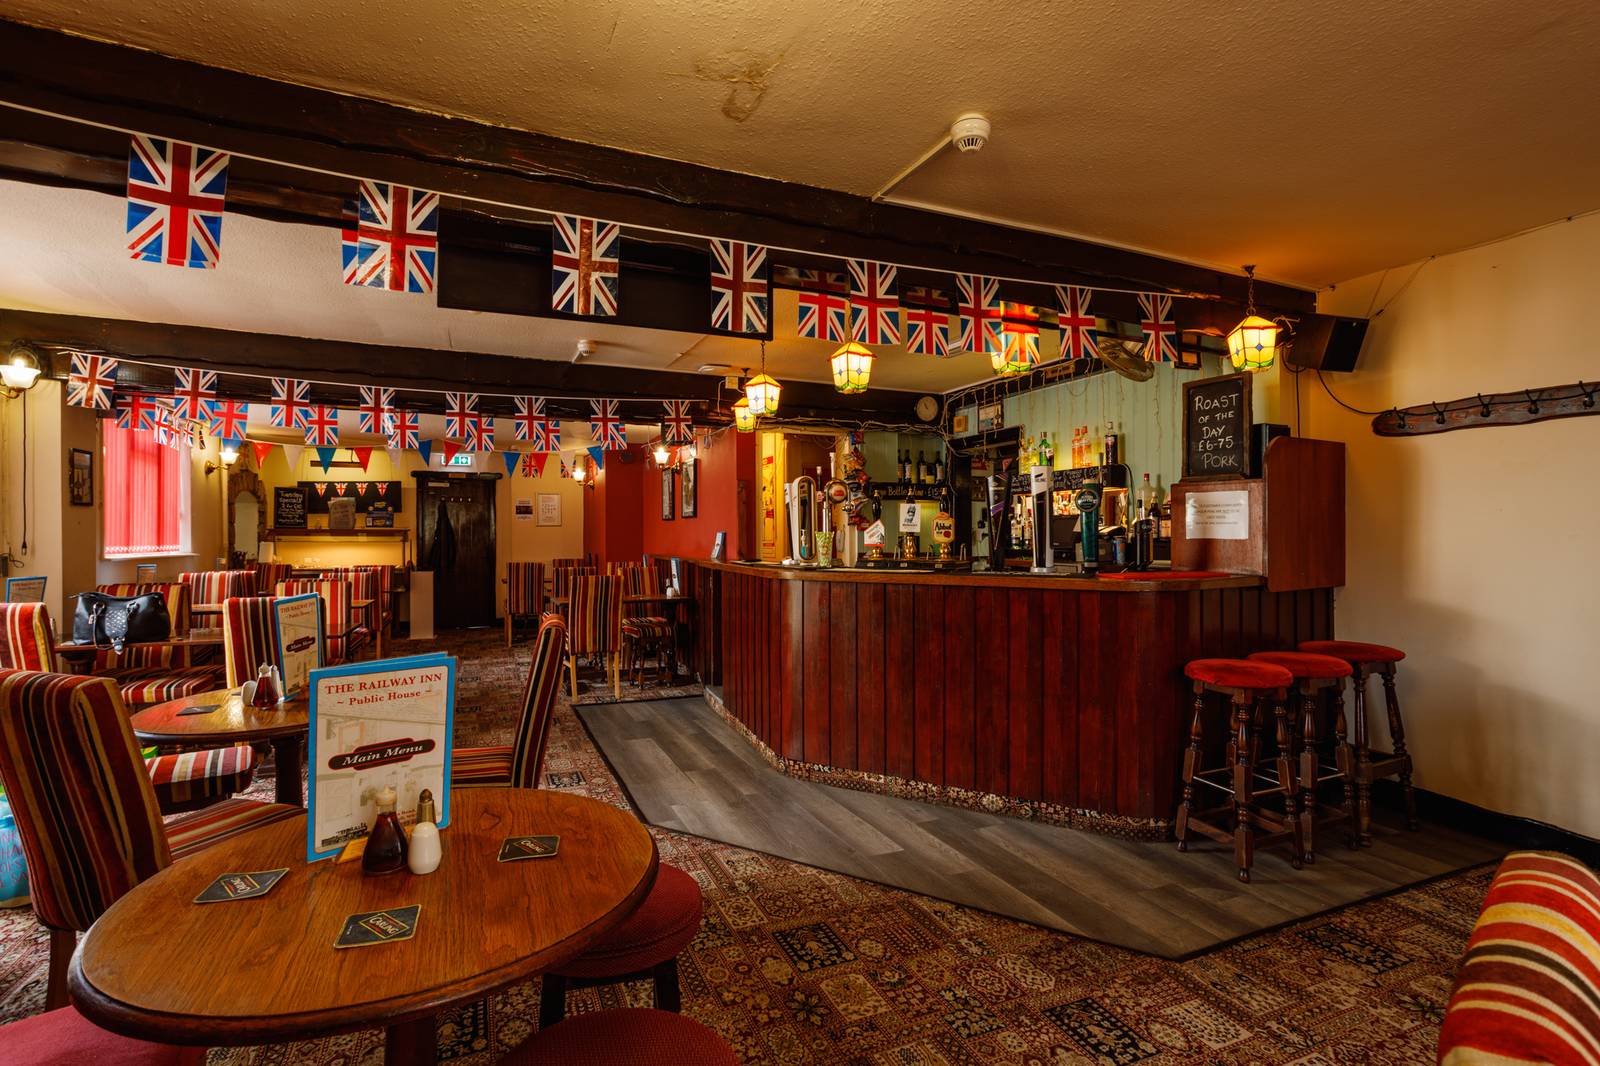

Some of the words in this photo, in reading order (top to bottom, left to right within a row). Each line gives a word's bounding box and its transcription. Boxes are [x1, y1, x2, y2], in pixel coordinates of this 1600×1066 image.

[1194, 393, 1240, 411] ROAST
[1198, 415, 1210, 424] OF
[1214, 410, 1235, 421] THE
[1202, 425, 1226, 440] DAY
[1201, 452, 1239, 469] PORK
[324, 683, 355, 695] THE
[359, 675, 417, 692] RAILWAY
[420, 672, 443, 684] INN
[349, 694, 385, 706] Public
[388, 690, 421, 701] House
[341, 751, 381, 766] Main
[383, 744, 424, 759] Menu
[369, 917, 401, 934] CARLING
